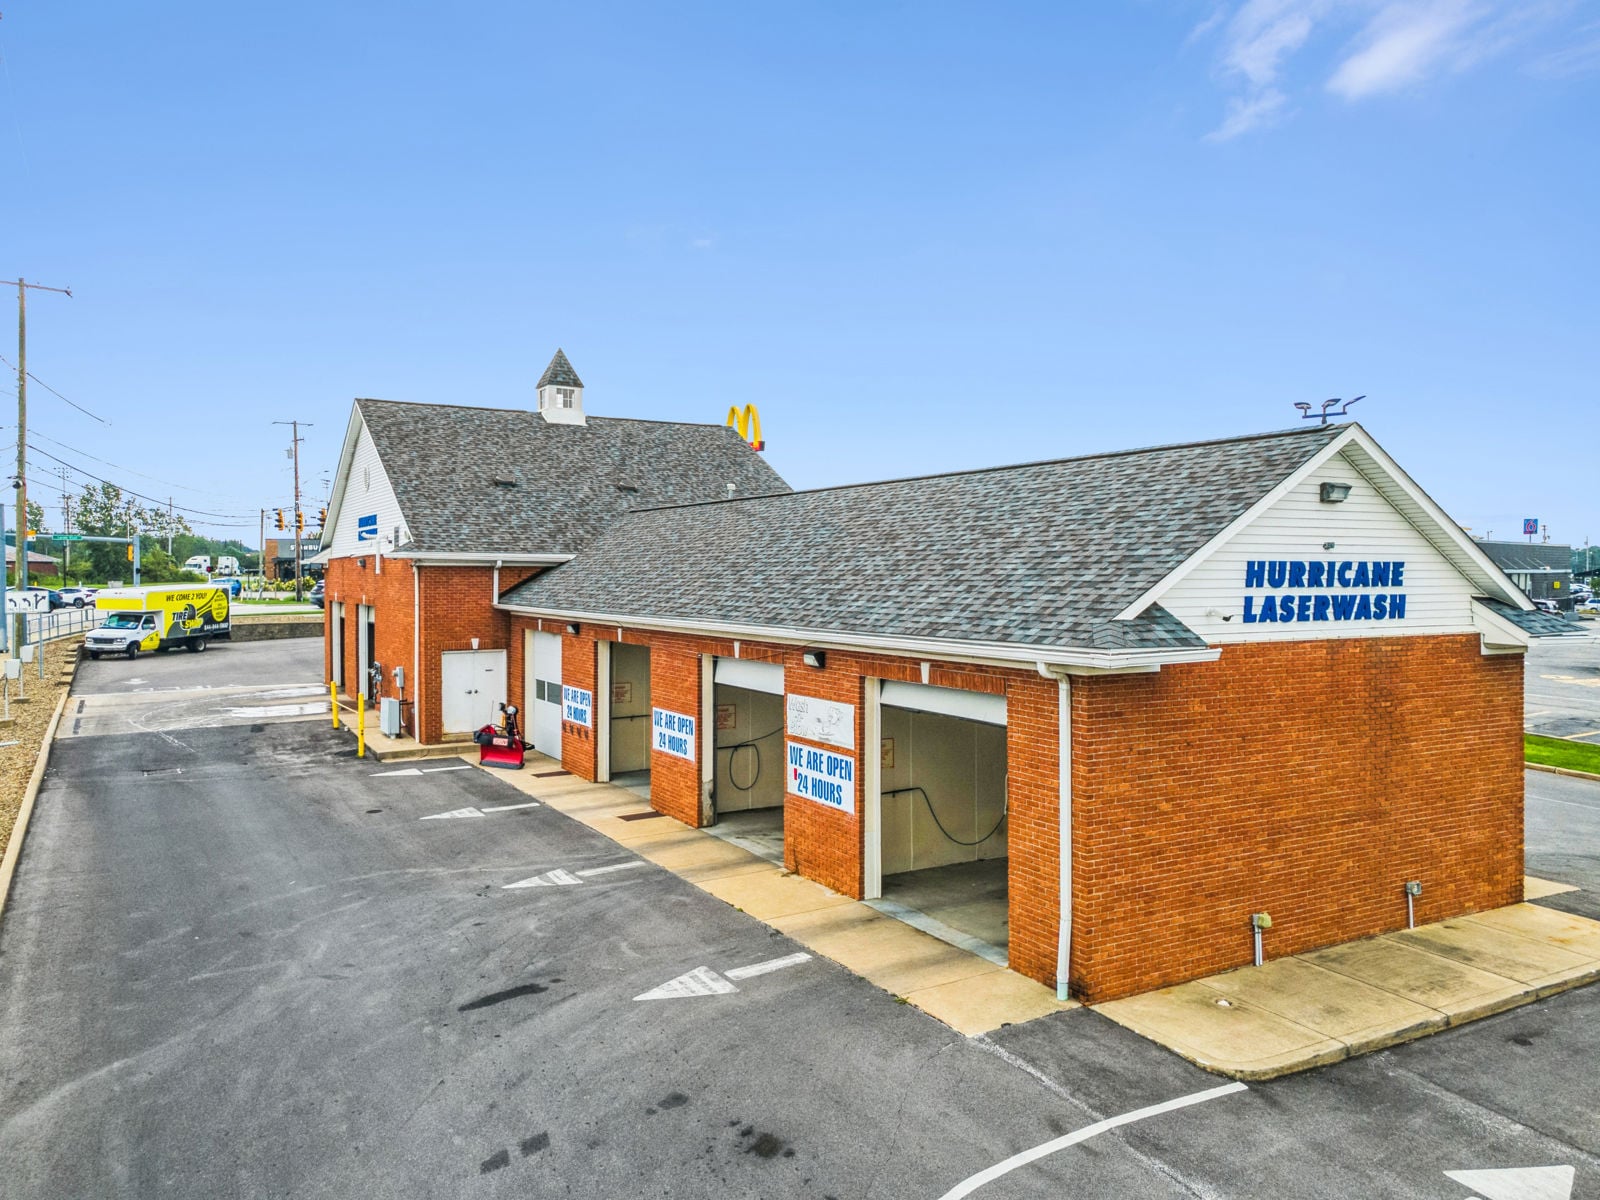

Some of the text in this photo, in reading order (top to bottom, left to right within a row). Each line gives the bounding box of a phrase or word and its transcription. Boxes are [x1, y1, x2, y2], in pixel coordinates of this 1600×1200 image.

[1245, 560, 1405, 588] HURRICANE
[176, 593, 190, 601] COME
[1243, 594, 1406, 623] LASERWASH
[172, 612, 188, 621] TIRE
[564, 687, 591, 707] WE ARE OPEN
[567, 704, 587, 724] 24 HOURS
[654, 710, 694, 736] WE ARE OPEN
[659, 731, 688, 756] 24 HOURS
[789, 745, 852, 782] WE ARE OPEN
[797, 772, 842, 806] 24 HOURS
